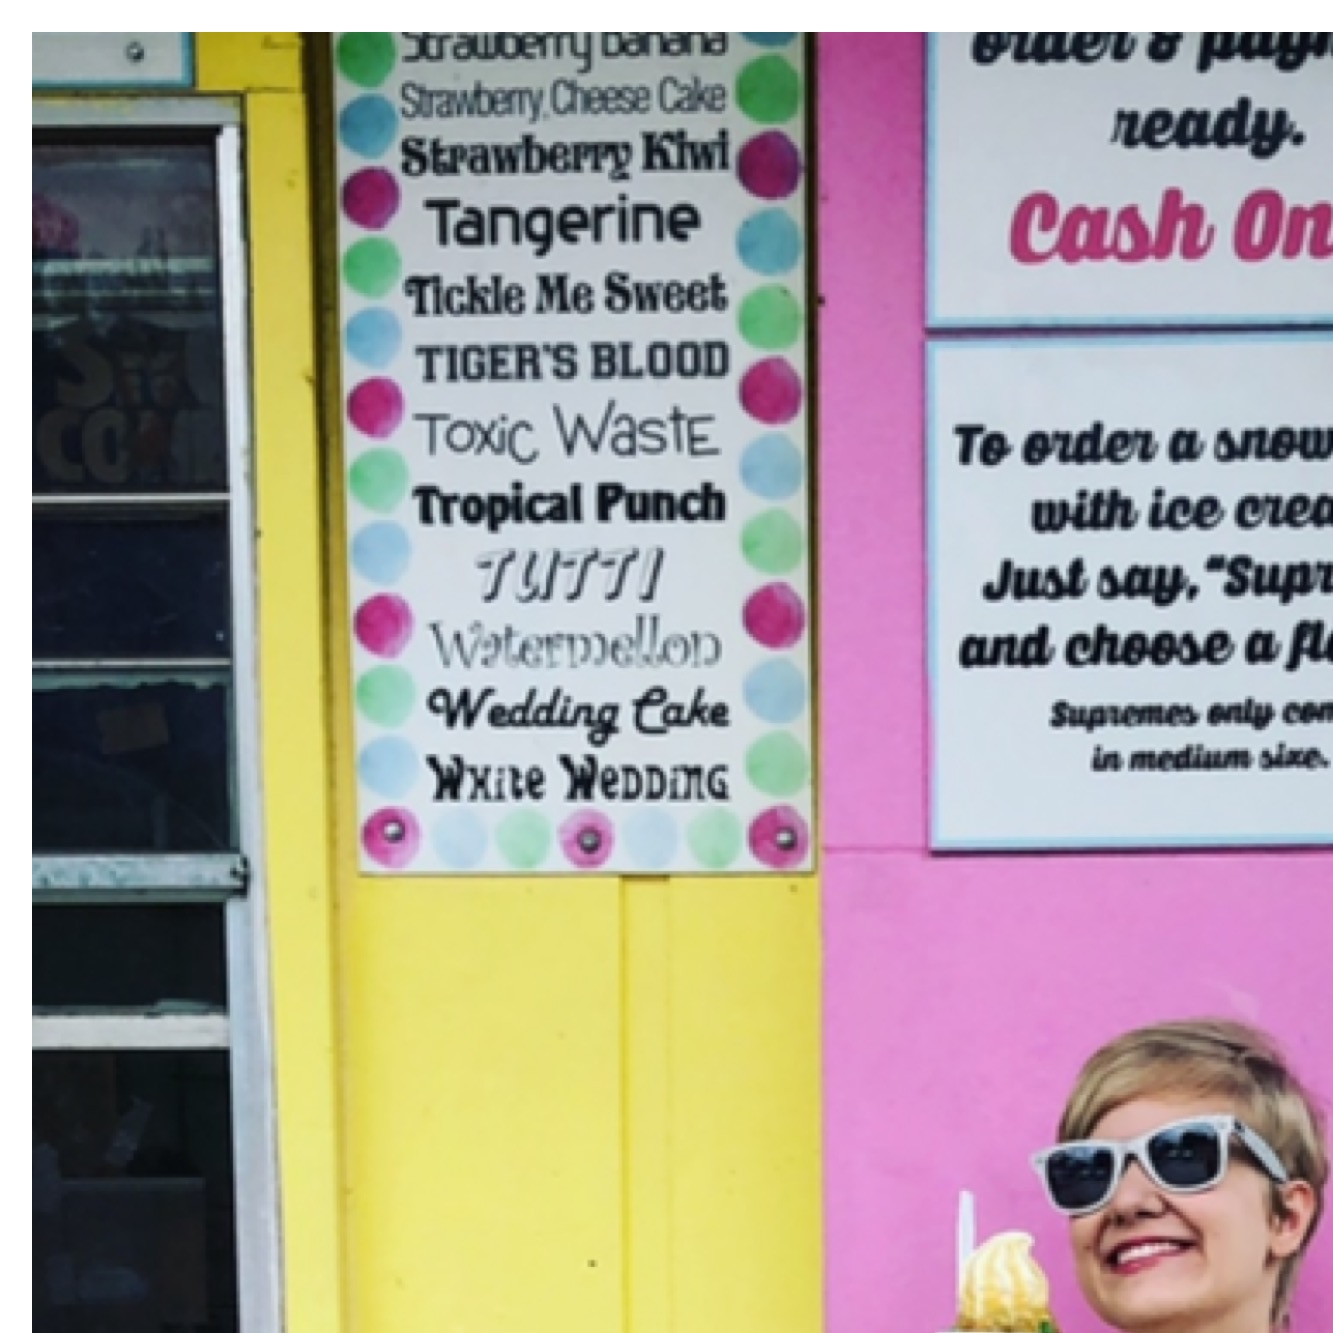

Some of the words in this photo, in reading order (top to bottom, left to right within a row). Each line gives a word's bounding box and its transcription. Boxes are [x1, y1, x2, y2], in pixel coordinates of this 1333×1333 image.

[549, 77, 651, 115] Cheese
[658, 75, 728, 115] Cake
[1110, 96, 1306, 160] ready.
[400, 133, 633, 181] Strawberry
[641, 127, 730, 171] Kiwi
[422, 193, 702, 257] Tangerine
[1010, 188, 1213, 265] Cash
[404, 274, 526, 317] Tickle
[535, 272, 595, 315] Me
[604, 271, 729, 314] Sweet
[414, 342, 578, 383] TIGER'S
[590, 340, 730, 380] BLOOD
[954, 423, 1012, 466] To
[1021, 420, 1159, 466] order
[1167, 428, 1205, 463] a
[411, 480, 584, 534] Tropical
[596, 481, 726, 523] Punch
[1031, 488, 1139, 534] with
[1147, 487, 1225, 532] ice
[982, 557, 1088, 602] Just
[1096, 564, 1200, 607] say,
[958, 623, 1056, 669] and
[1064, 623, 1236, 668] choose
[1244, 629, 1282, 666] a
[426, 687, 620, 748] Wedding
[632, 685, 730, 735] Cake
[1049, 699, 1201, 734] Supremes
[1206, 697, 1276, 731] only
[1091, 744, 1125, 773] in
[1127, 743, 1254, 772] medium
[1258, 742, 1330, 771] size.
